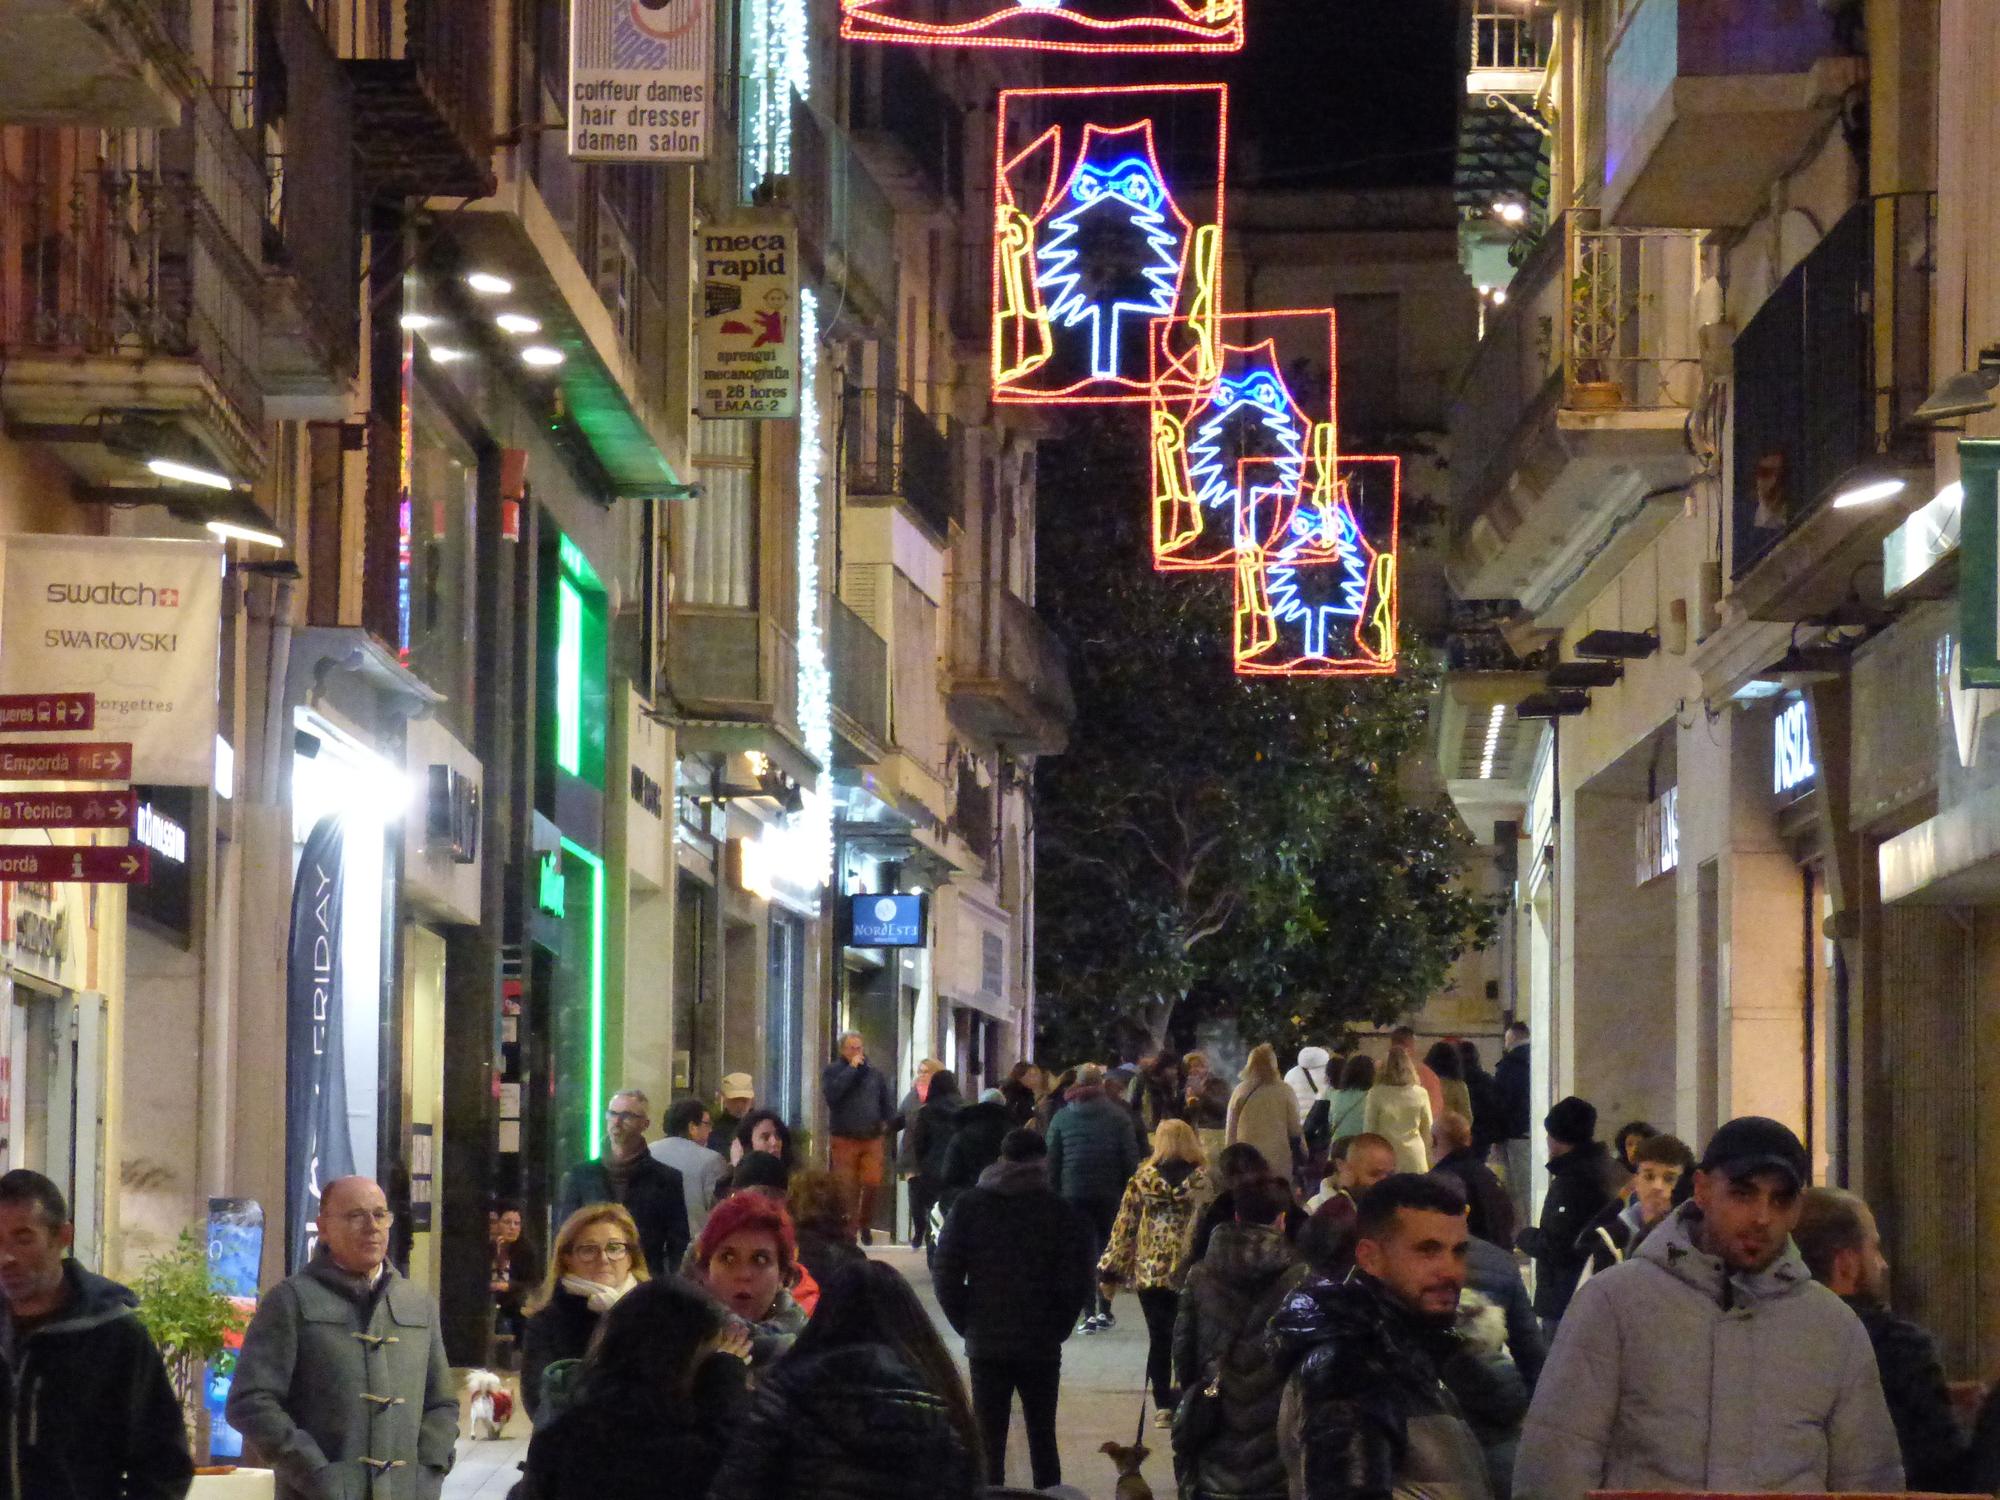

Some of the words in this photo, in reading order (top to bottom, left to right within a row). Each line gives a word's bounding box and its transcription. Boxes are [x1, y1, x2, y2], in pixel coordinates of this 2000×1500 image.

[575, 80, 642, 101] coiffeur
[647, 80, 703, 102] dames
[580, 104, 616, 126] hair
[628, 105, 700, 127] dresser
[577, 129, 639, 151] damen
[649, 130, 700, 151] salon
[705, 235, 786, 252] meca
[707, 252, 786, 281] rapid
[726, 384, 745, 398] 28
[750, 384, 788, 399] hores
[47, 581, 157, 607] swatch
[45, 629, 177, 651] SWAROVSKI
[3, 753, 69, 775] Empordà
[314, 863, 331, 1055] FRIDAY
